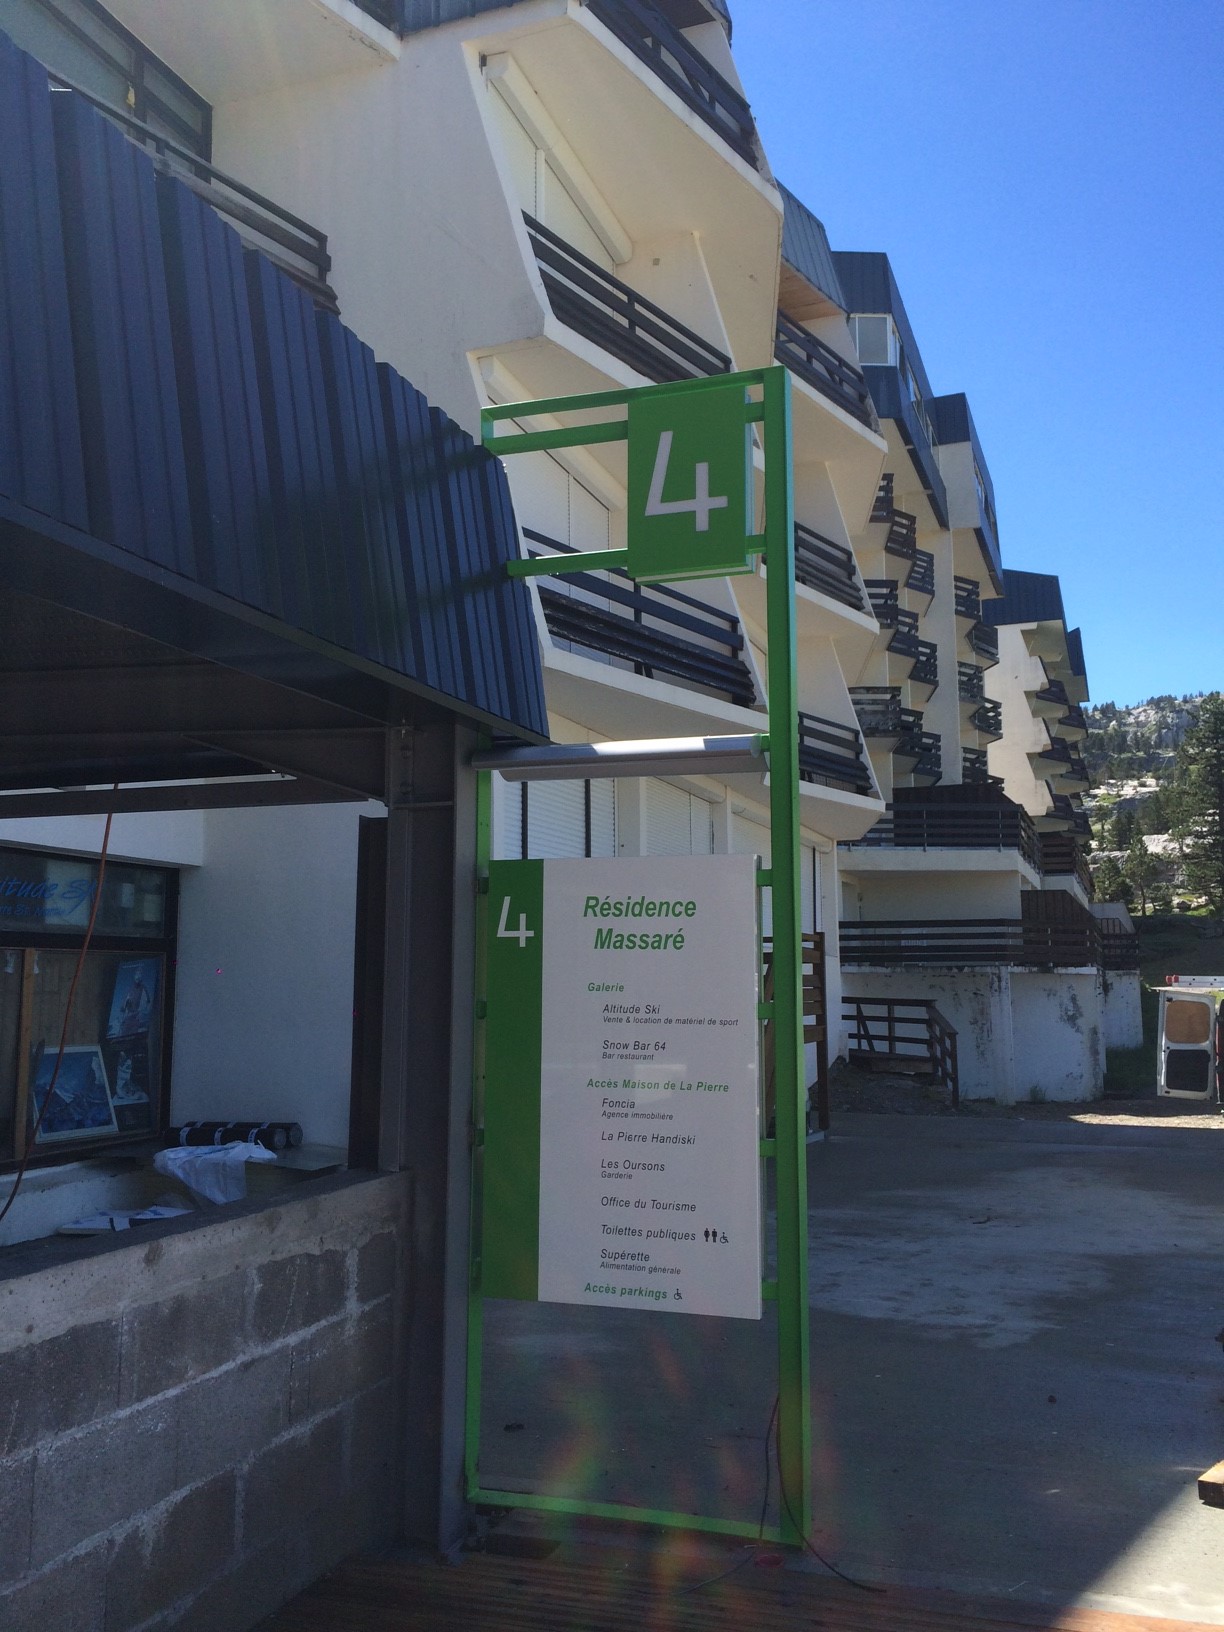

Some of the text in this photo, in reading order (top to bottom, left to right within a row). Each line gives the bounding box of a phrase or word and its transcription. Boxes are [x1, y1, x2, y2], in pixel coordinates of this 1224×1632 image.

[645, 430, 729, 532] 4
[583, 895, 697, 918] Résidence
[496, 895, 535, 948] 4
[594, 927, 686, 950] Massaré
[587, 982, 625, 992] Galerie
[602, 1004, 660, 1014] Altitude Ski
[602, 1016, 739, 1027] Vente & location de matériel de sport
[602, 1040, 666, 1051] Snow Bar 64
[602, 1052, 654, 1061] Bar restaurant
[586, 1078, 730, 1093] Accès Maison de La Pierre
[601, 1098, 636, 1109] Foncia
[601, 1110, 674, 1121] Agence immobilière
[601, 1131, 696, 1145] La Pierre Handiski
[601, 1158, 666, 1172] Les Oursons
[601, 1171, 633, 1180] Garderie
[601, 1196, 697, 1212] Office du Tourisme
[601, 1224, 697, 1242] Toilettes publiques
[600, 1248, 650, 1262] Supérette
[599, 1261, 682, 1275] Alimentation générale
[584, 1282, 668, 1301] Accès parkings
